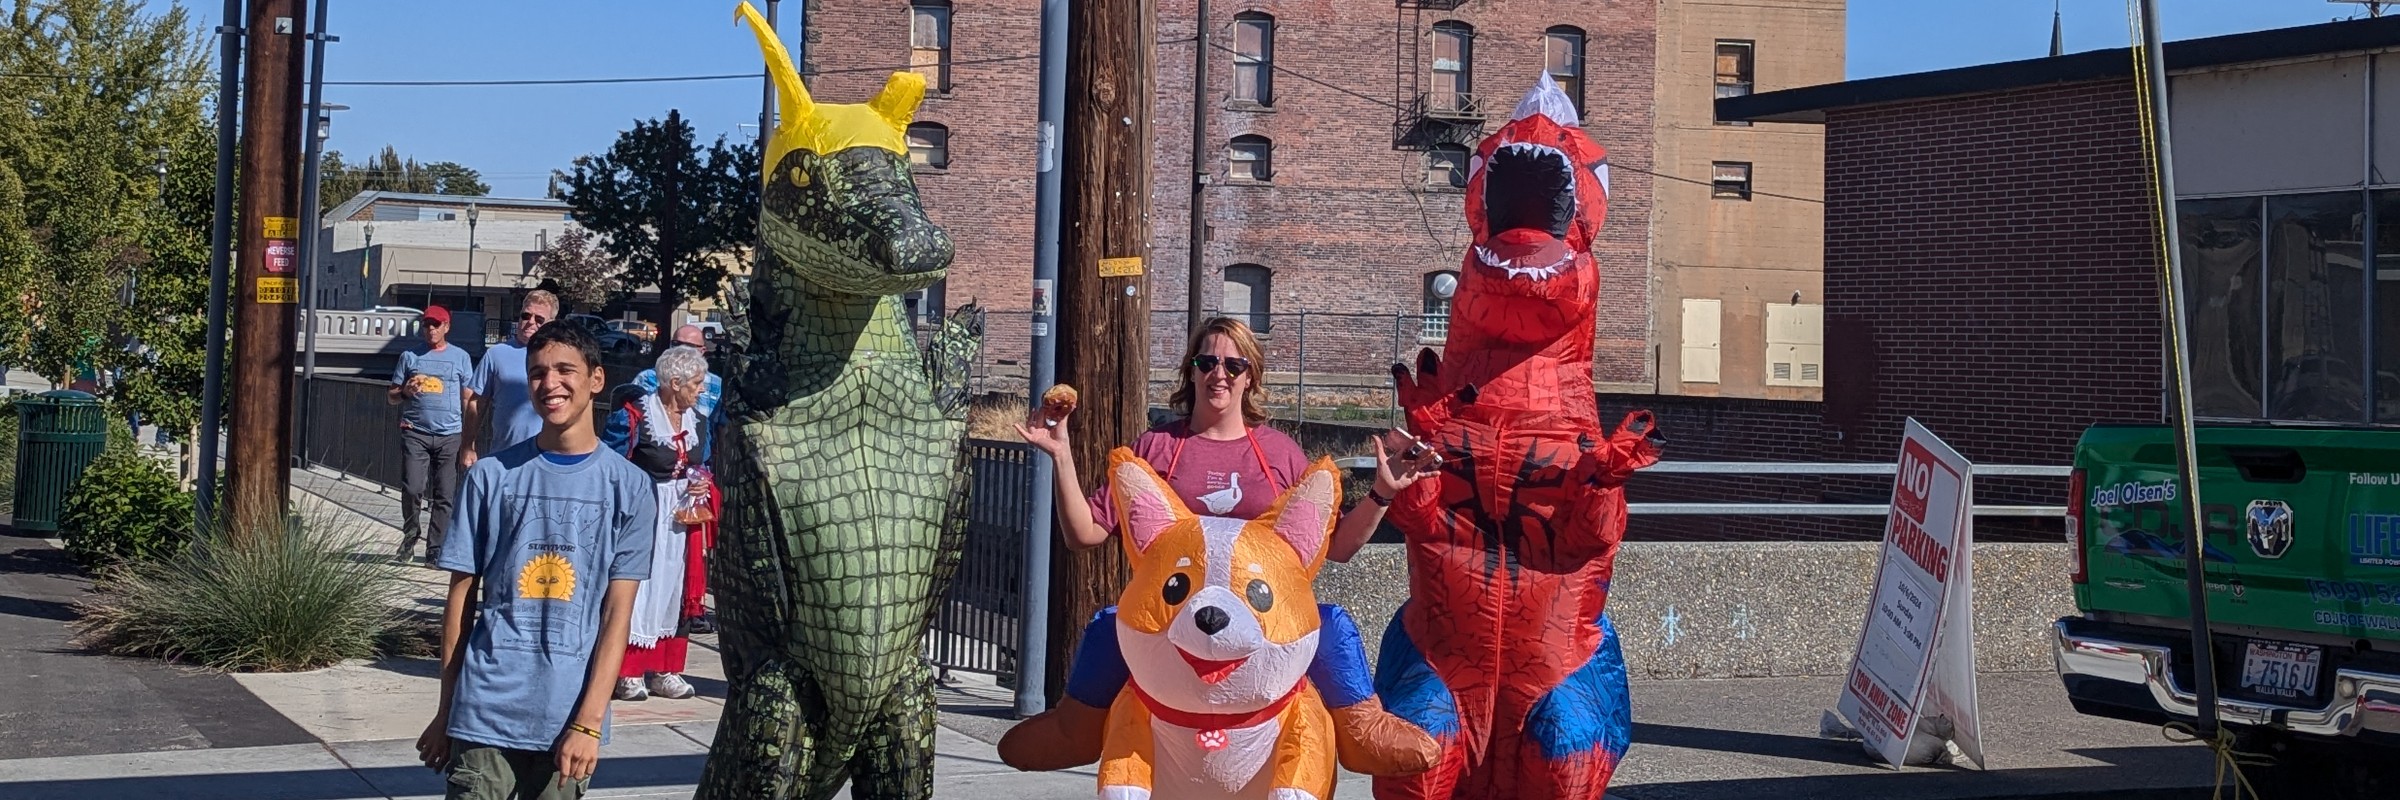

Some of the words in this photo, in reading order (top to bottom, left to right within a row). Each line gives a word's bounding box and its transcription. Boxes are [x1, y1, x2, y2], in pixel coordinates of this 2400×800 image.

[267, 246, 295, 256] REVERSE
[273, 257, 289, 267] FEED
[1902, 452, 1929, 500] NO
[2349, 472, 2388, 485] Follow
[2091, 482, 2119, 507] Joel
[2122, 479, 2176, 505] Olsen's
[1890, 510, 1949, 583] PARKING
[2359, 557, 2384, 565] LIMITED
[2306, 577, 2371, 607] (509)
[1897, 599, 1914, 623] Sunday
[2249, 647, 2293, 660] WASHINGTON
[2260, 659, 2300, 689] 7516
[2303, 664, 2316, 690] U
[1855, 668, 1871, 695] TOW
[1868, 683, 1890, 713] AWAY
[1886, 700, 1907, 731] ZONE
